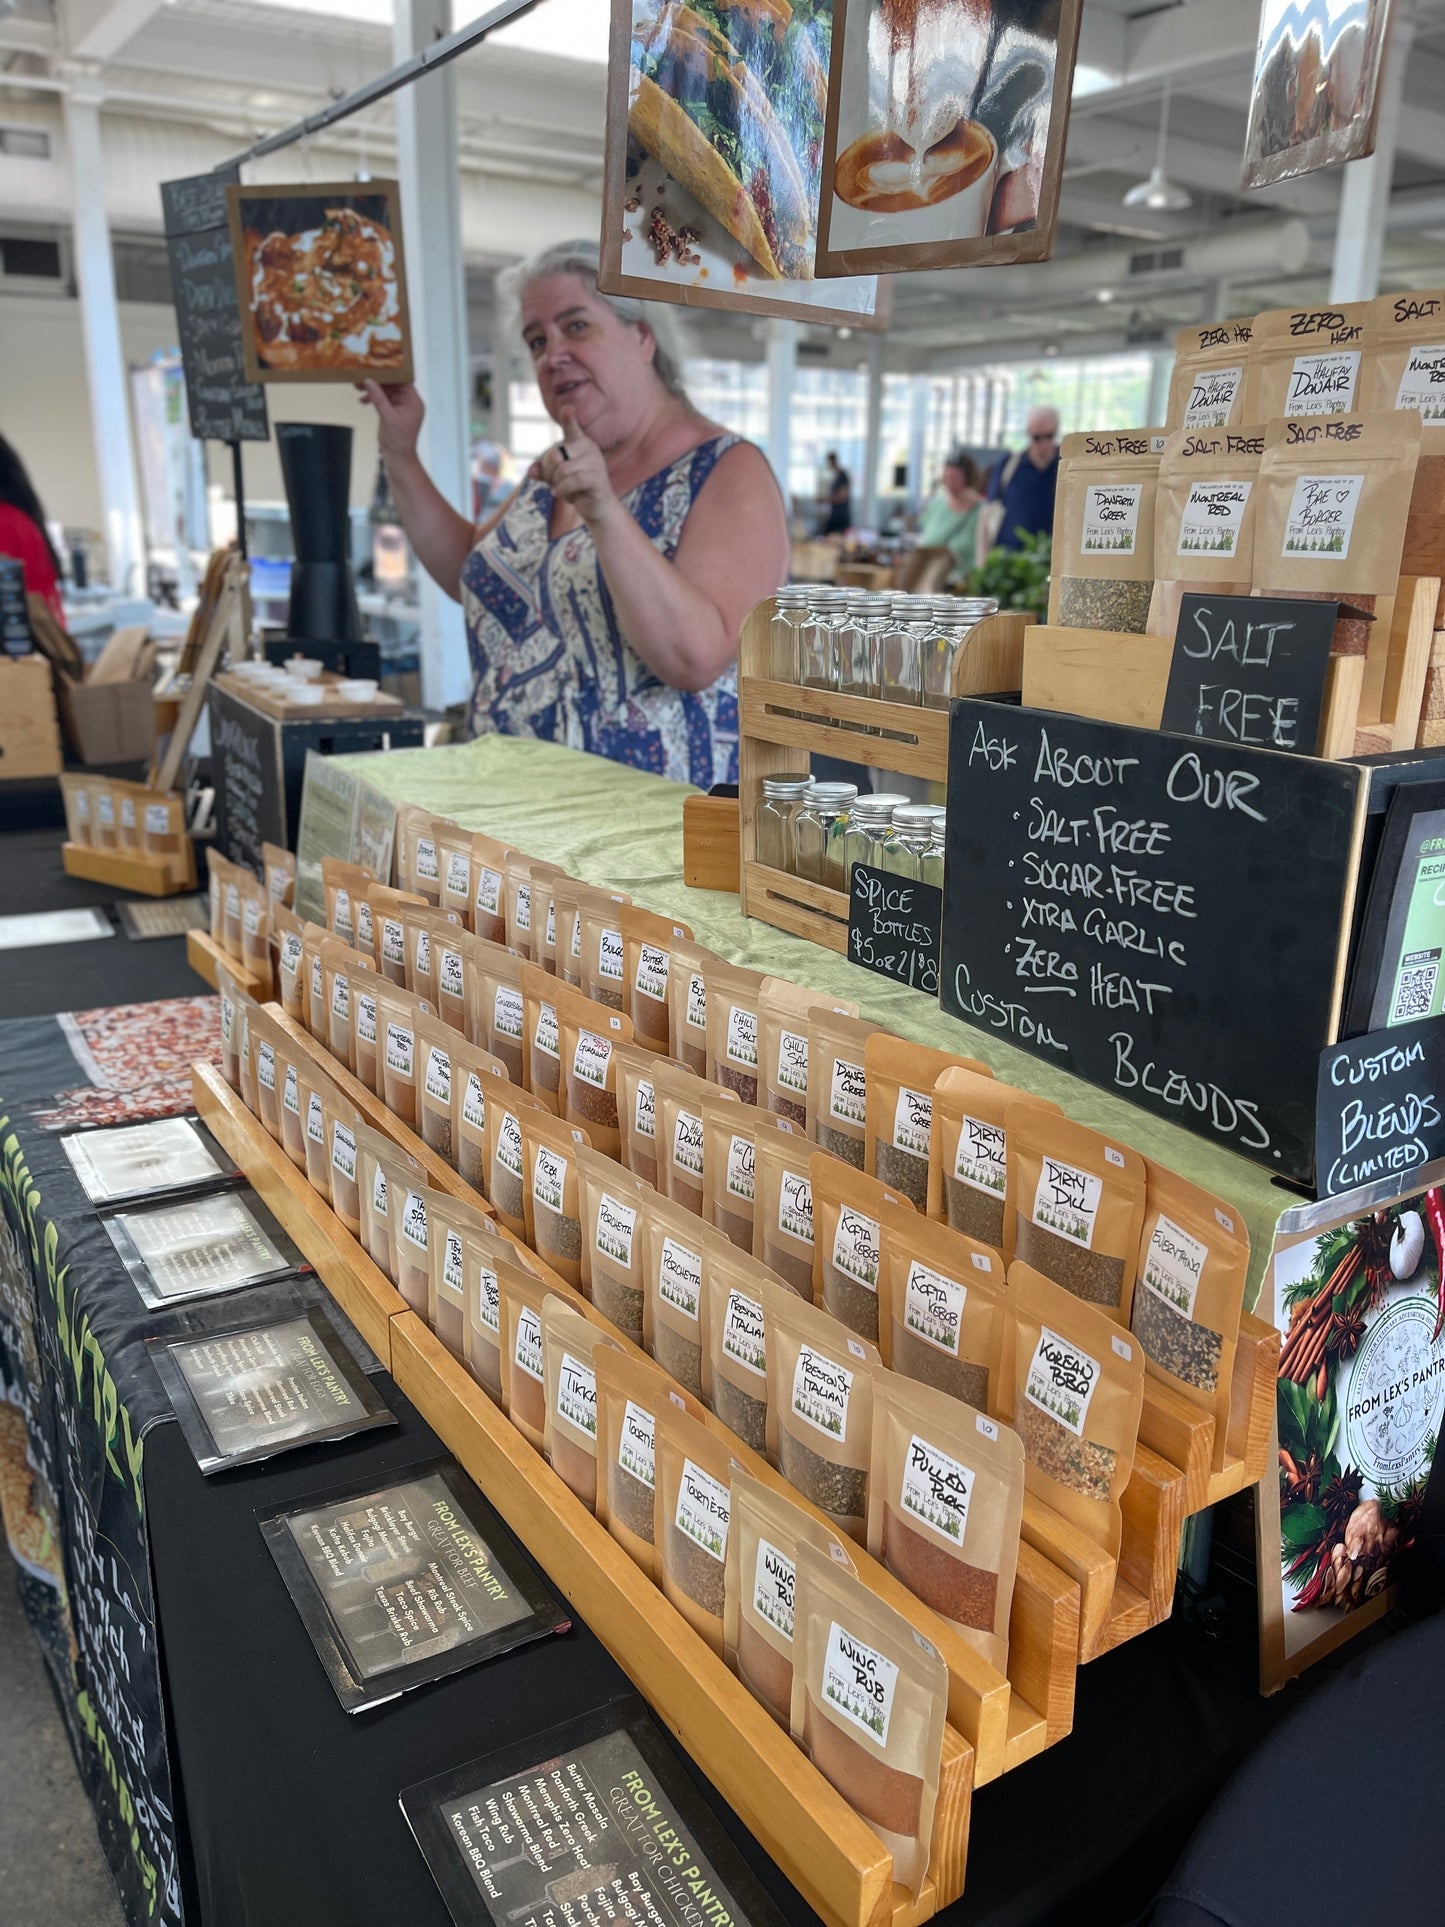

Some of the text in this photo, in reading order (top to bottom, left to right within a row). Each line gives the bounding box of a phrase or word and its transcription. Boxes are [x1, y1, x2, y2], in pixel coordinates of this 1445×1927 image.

[1199, 328, 1230, 349] ZERO
[1290, 312, 1345, 336] ZERO
[1331, 326, 1363, 345] HEAT
[1292, 371, 1350, 398] DONAIR
[1094, 492, 1135, 507] DANFORTH
[1099, 507, 1127, 521] GREEK
[1190, 490, 1245, 503] MONTREAL
[1208, 504, 1231, 516] RED
[1183, 607, 1297, 667] SALT
[1195, 683, 1299, 747] FREE
[967, 721, 1267, 822] ASK ABOUT OUR
[855, 868, 914, 913] SPICE
[851, 927, 874, 963] $5
[869, 907, 933, 945] BOTTLES
[1021, 897, 1187, 966] XTRA GARLIC
[1015, 937, 1174, 1014] ZERO HEAT
[1405, 950, 1431, 962] WEBSITE
[954, 964, 1068, 1051] CUSTOM
[1331, 1041, 1426, 1087] CUSTOM
[965, 1118, 1006, 1148] DIRTY
[1340, 1091, 1441, 1155] BLENDS
[1045, 1161, 1087, 1193] DIRTY
[1326, 1137, 1430, 1194] (LIMITED)
[1051, 1184, 1094, 1213] DILL
[600, 1204, 632, 1236] PORCHETTA
[841, 1212, 872, 1242] KOFTA
[1152, 1229, 1201, 1278] EVERYTHING
[911, 1271, 948, 1303] KOFTA
[928, 1298, 958, 1327] KEBOB
[297, 1336, 351, 1406] FROM LEX'S PANTRY
[800, 1352, 838, 1388] PRESTON
[1039, 1338, 1094, 1380] KOREAN
[562, 1367, 597, 1403] TIKKA
[803, 1376, 844, 1408] ITALIAN
[1050, 1366, 1090, 1398] BBQ
[1349, 1393, 1380, 1423] FROM
[1384, 1378, 1410, 1404] LEX'S
[982, 1421, 993, 1434] 10
[912, 1443, 967, 1494] PULLED
[930, 1477, 966, 1516] PORK
[310, 1524, 325, 1547] Korean
[328, 1558, 344, 1577] Blend
[405, 1520, 420, 1541] Burger
[432, 1501, 508, 1601] FROM LEX'S PANTRY
[427, 1520, 479, 1589] GREAT FOR BEEF
[375, 1586, 413, 1647] Texas Brisket Rub
[396, 1590, 420, 1631] Taco Spice
[405, 1579, 439, 1634] Beef Shawarma
[427, 1588, 448, 1615] Rib Rub
[428, 1562, 473, 1632] Montreal Steak Spice
[840, 1637, 877, 1676] WING
[852, 1665, 885, 1703] RUB
[518, 1784, 560, 1849] Montreal Red
[551, 1770, 598, 1844] Danforth Greek
[566, 1763, 608, 1830] Butter Masala
[468, 1805, 495, 1852] Fish Taco
[485, 1798, 515, 1844] Wing Rub
[502, 1791, 553, 1873] Shawarma Blend
[534, 1777, 592, 1870] Memphis Zero Heat
[610, 1787, 645, 1832] GREAT
[637, 1834, 664, 1866] FOR
[621, 1770, 662, 1820] FROM
[652, 1820, 690, 1866] LEX'S
[451, 1812, 503, 1899] Korean BBQ Blend
[594, 1886, 616, 1918] Fajita
[611, 1878, 638, 1920] Bulgogi
[628, 1871, 645, 1892] Bay
